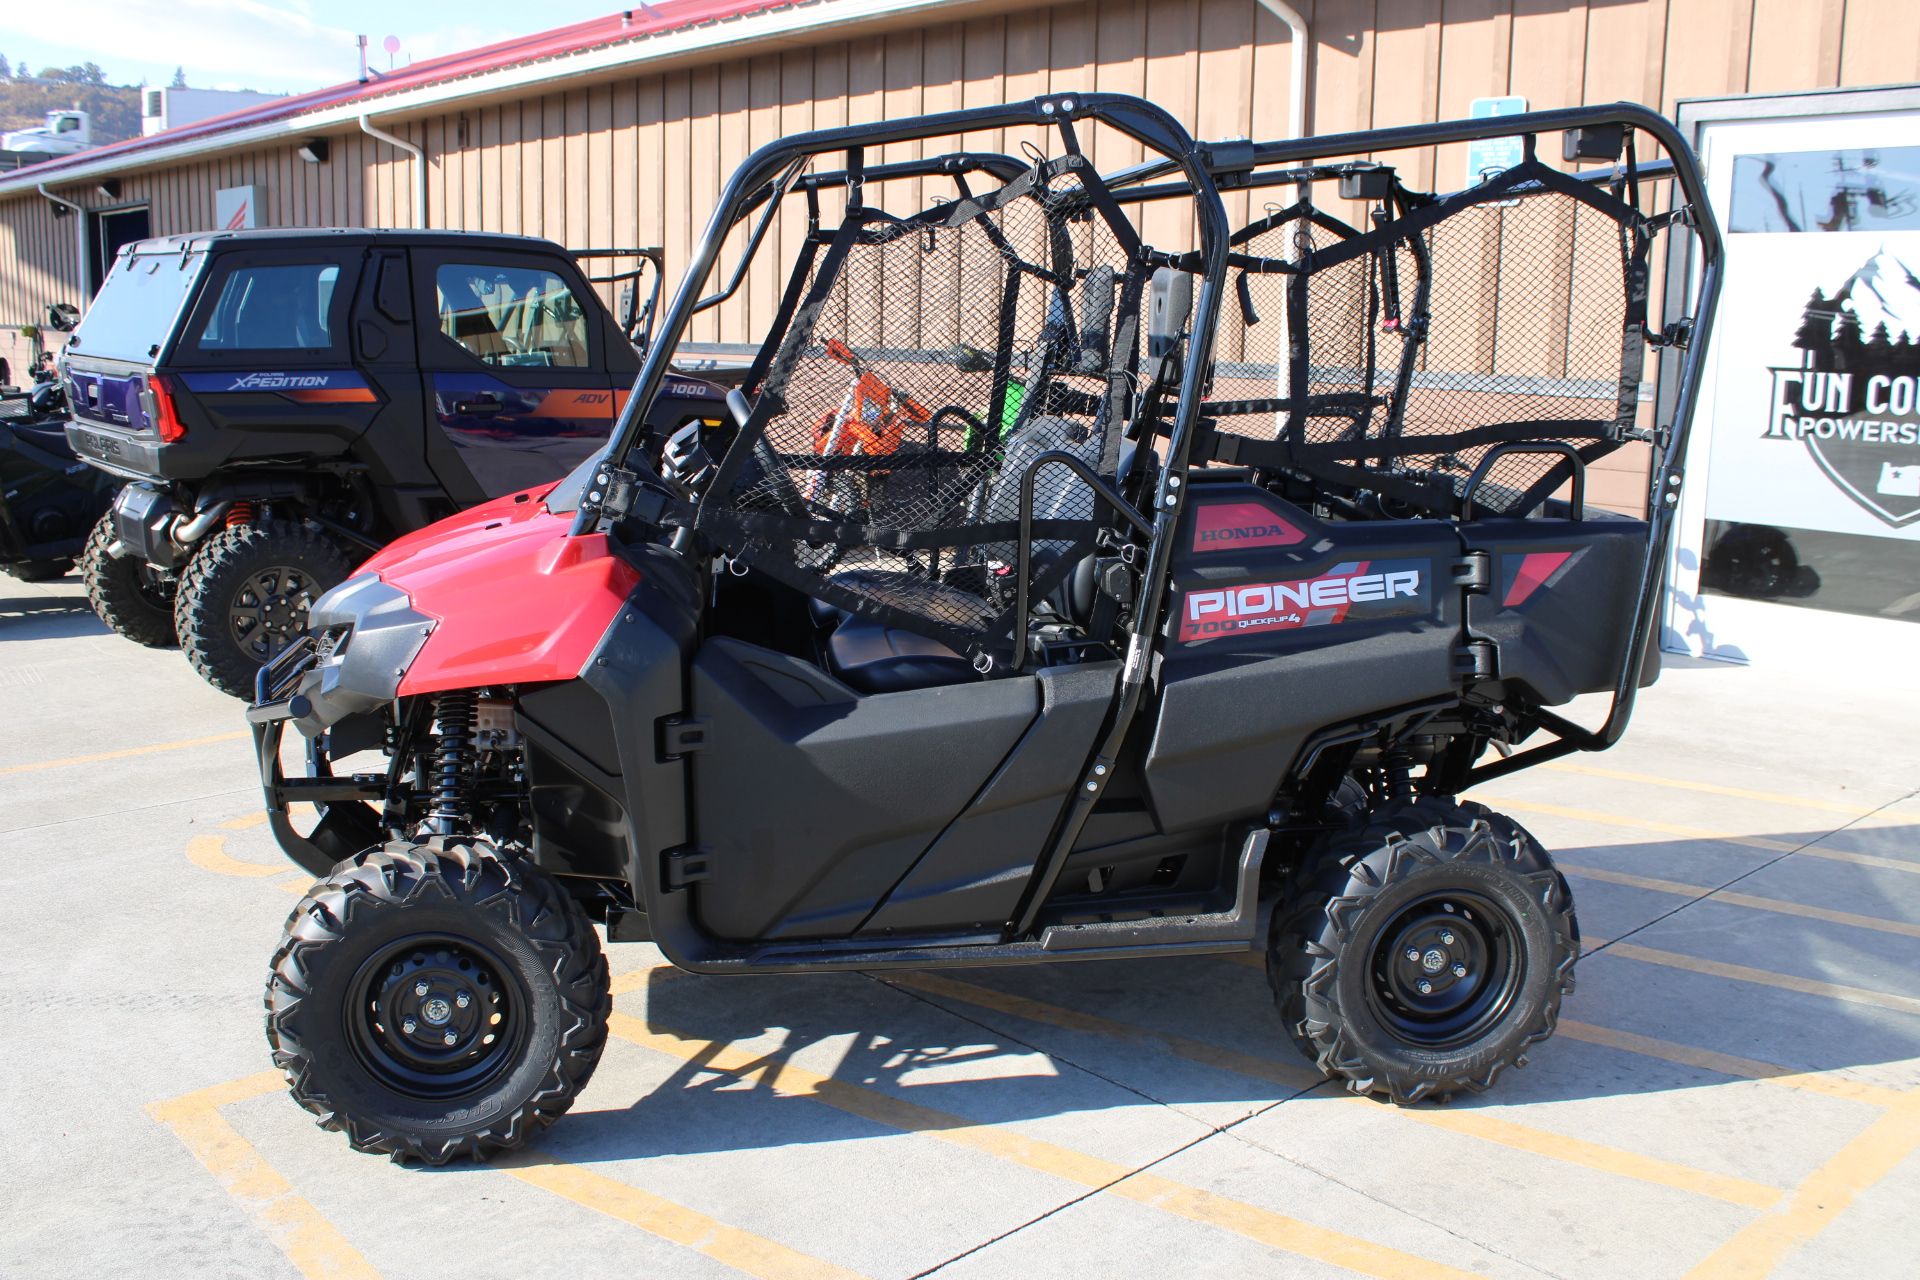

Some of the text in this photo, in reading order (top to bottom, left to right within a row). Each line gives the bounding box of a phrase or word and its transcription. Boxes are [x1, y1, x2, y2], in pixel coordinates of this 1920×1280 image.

[227, 373, 329, 391] XPEDITION
[671, 384, 707, 396] 1000
[572, 393, 609, 405] ADV
[1762, 367, 1920, 438] FUN CO
[1798, 416, 1920, 445] POWERS
[1200, 525, 1285, 542] HONDA
[1189, 570, 1420, 621] PIONEER
[1186, 620, 1237, 635] 700
